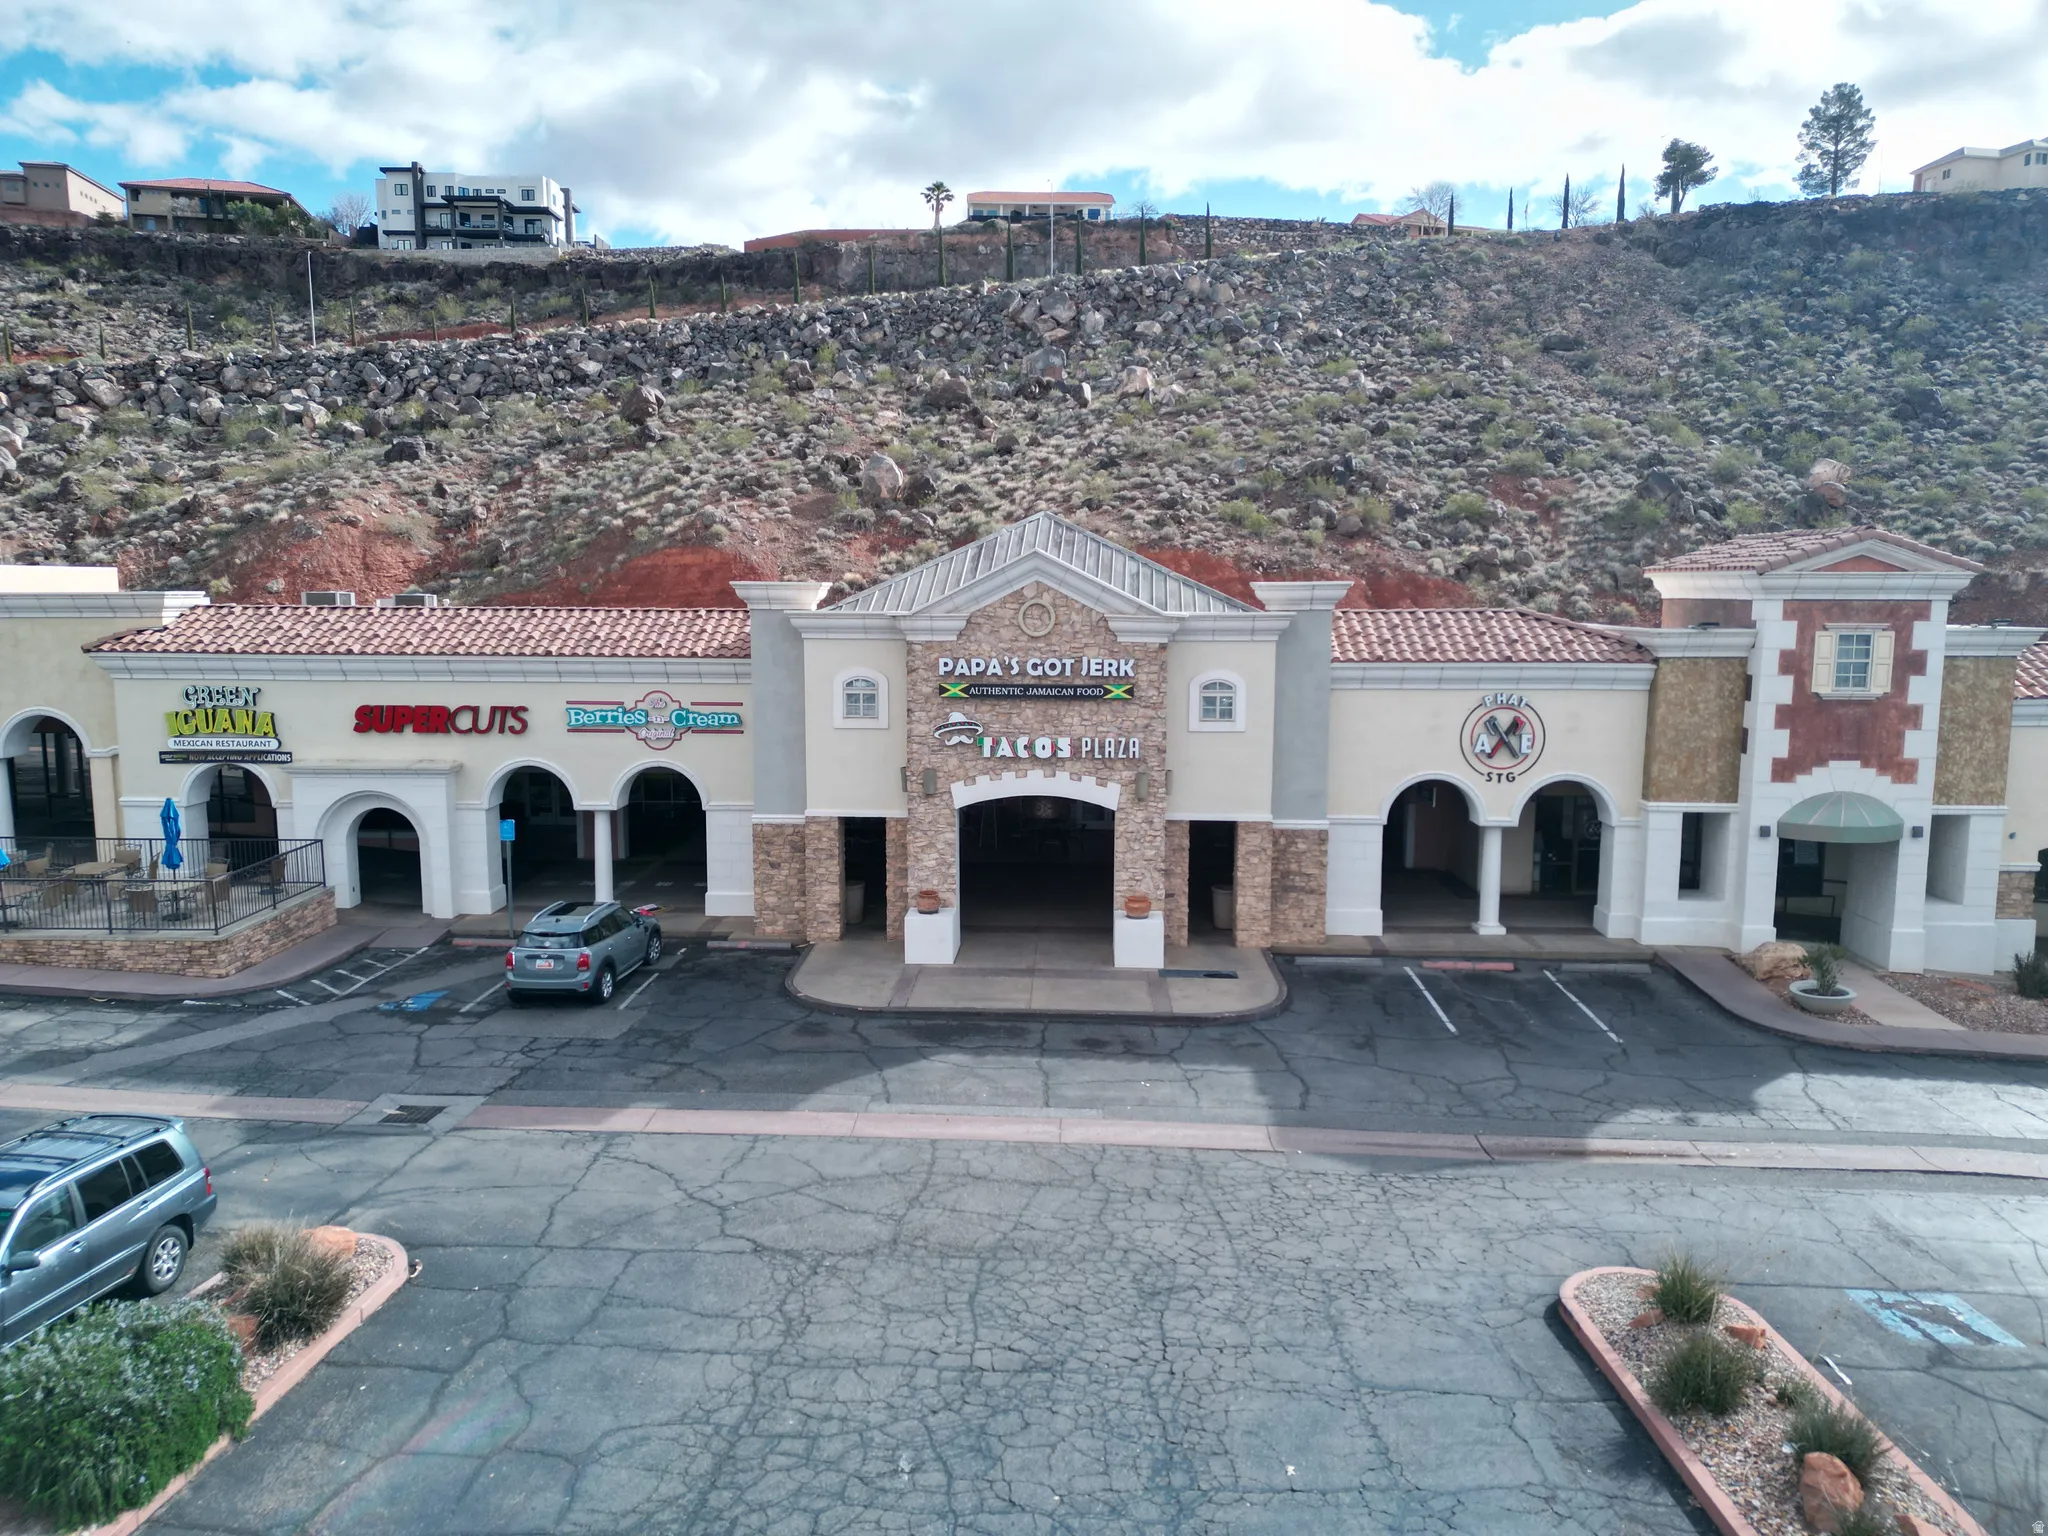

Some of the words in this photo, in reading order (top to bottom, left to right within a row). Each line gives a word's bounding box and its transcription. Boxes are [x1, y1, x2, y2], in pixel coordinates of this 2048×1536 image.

[938, 656, 1020, 676] PAPA'S
[1026, 658, 1075, 677] GOT
[1080, 656, 1135, 677] JERK
[182, 685, 261, 708] GREEN
[969, 686, 1024, 695] AUTHENTIC
[1026, 686, 1074, 696] JAMAICAN
[1077, 687, 1104, 696] FOOD
[1483, 693, 1528, 708] PHAT
[165, 708, 278, 737] IGUANA
[353, 705, 530, 735] SUPERCUTS
[567, 708, 647, 726] Berries
[671, 709, 740, 727] Cream
[639, 727, 676, 740] Original
[173, 740, 213, 748] MEXICAN
[215, 740, 272, 748] RESTAURANT
[976, 736, 1074, 759] TACOS
[1081, 737, 1140, 759] PLAZA
[244, 753, 292, 762] APPLICATIONS
[1485, 772, 1516, 783] STG
